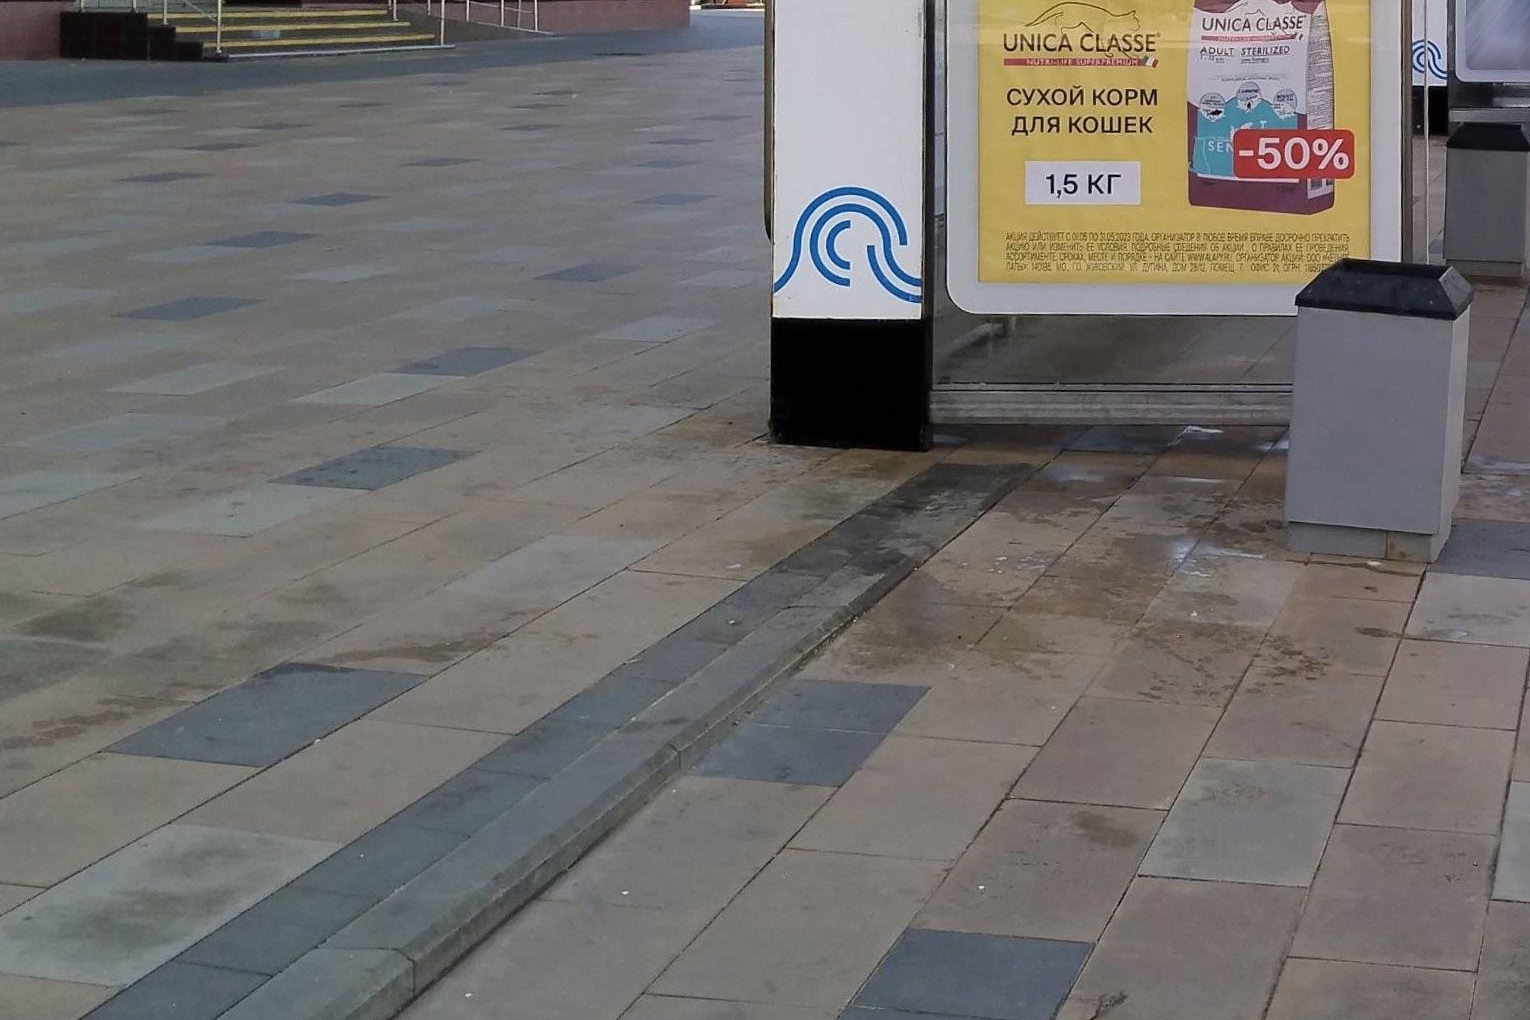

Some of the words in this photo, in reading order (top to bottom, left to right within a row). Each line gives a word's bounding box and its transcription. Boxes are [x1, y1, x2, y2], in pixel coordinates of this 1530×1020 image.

[1202, 17, 1251, 31] UNICA
[1003, 33, 1073, 52] UNICA
[1201, 47, 1235, 55] ADULT
[1241, 45, 1290, 55] STERILIZED
[1006, 85, 1084, 106] СУХОЙ
[1091, 88, 1158, 106] КОРМ
[1011, 116, 1060, 136] ДЛЯ
[1068, 116, 1153, 134] КОШЕК
[1239, 137, 1350, 170] -50%
[1045, 173, 1079, 199] 1,5
[1088, 174, 1122, 194] КГ
